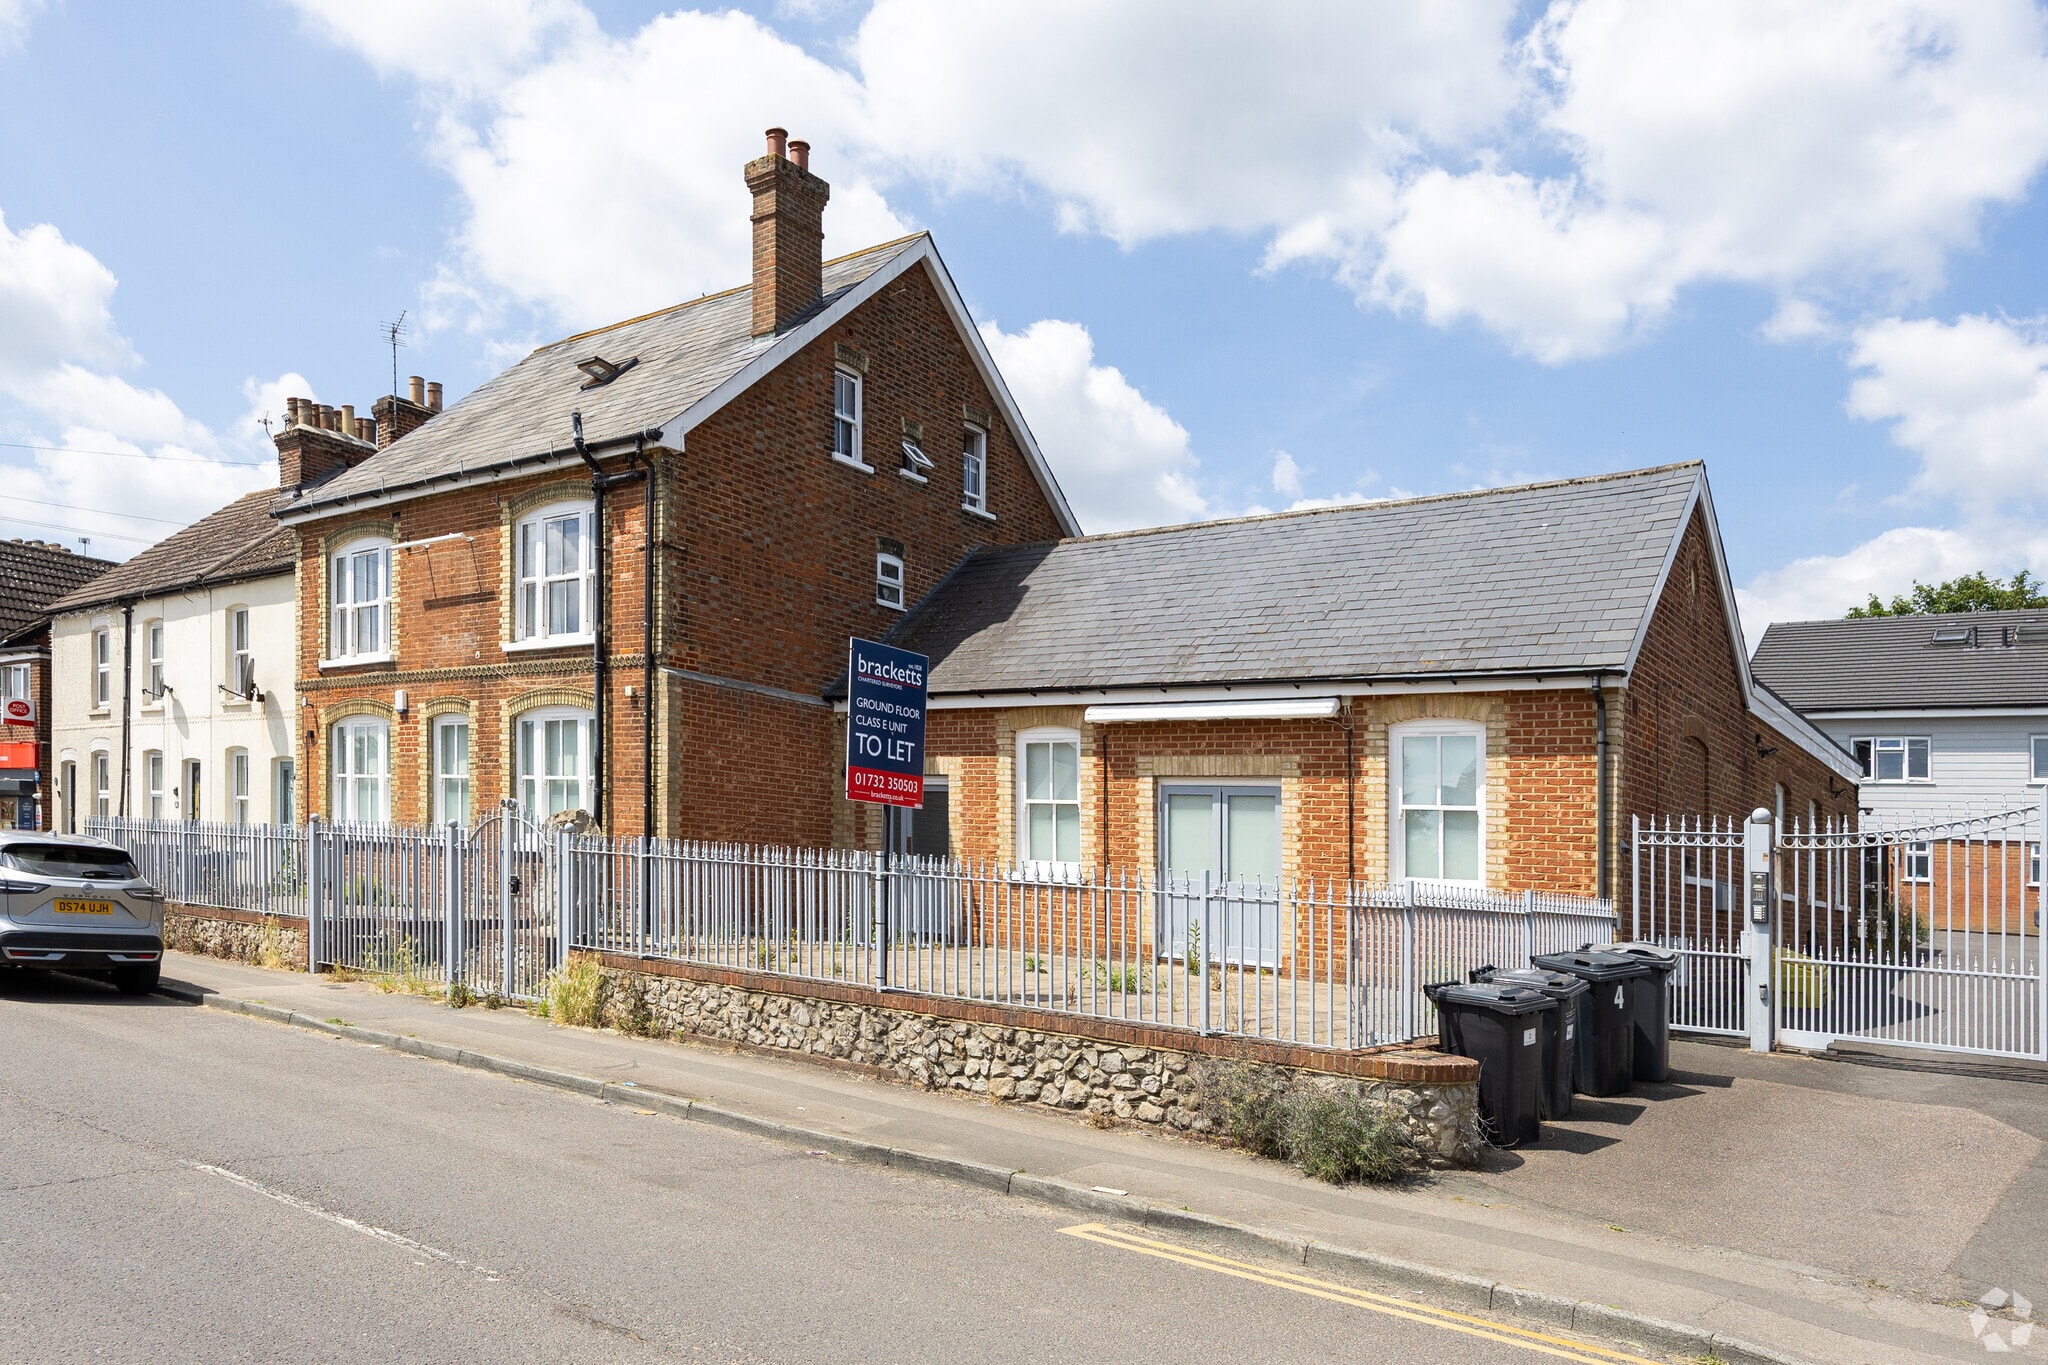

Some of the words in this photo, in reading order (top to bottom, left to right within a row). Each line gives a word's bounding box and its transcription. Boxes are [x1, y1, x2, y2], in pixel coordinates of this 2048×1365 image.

[858, 653, 922, 686] bracketts
[857, 675, 881, 686] CHARTERED
[881, 681, 903, 690] SURVEYORS
[856, 697, 894, 713] GROUND
[895, 705, 920, 719] FLOOR
[855, 714, 881, 729] CLASS
[882, 720, 887, 729] E
[888, 720, 908, 733] UNIT
[855, 732, 882, 757] TO
[887, 738, 915, 763] LET
[855, 772, 885, 788] 01732
[887, 777, 918, 793] 350503
[870, 790, 904, 801] bracketts.co.uk
[59, 901, 86, 912] DS74
[88, 903, 109, 913] UJH
[1614, 985, 1625, 1009] 4
